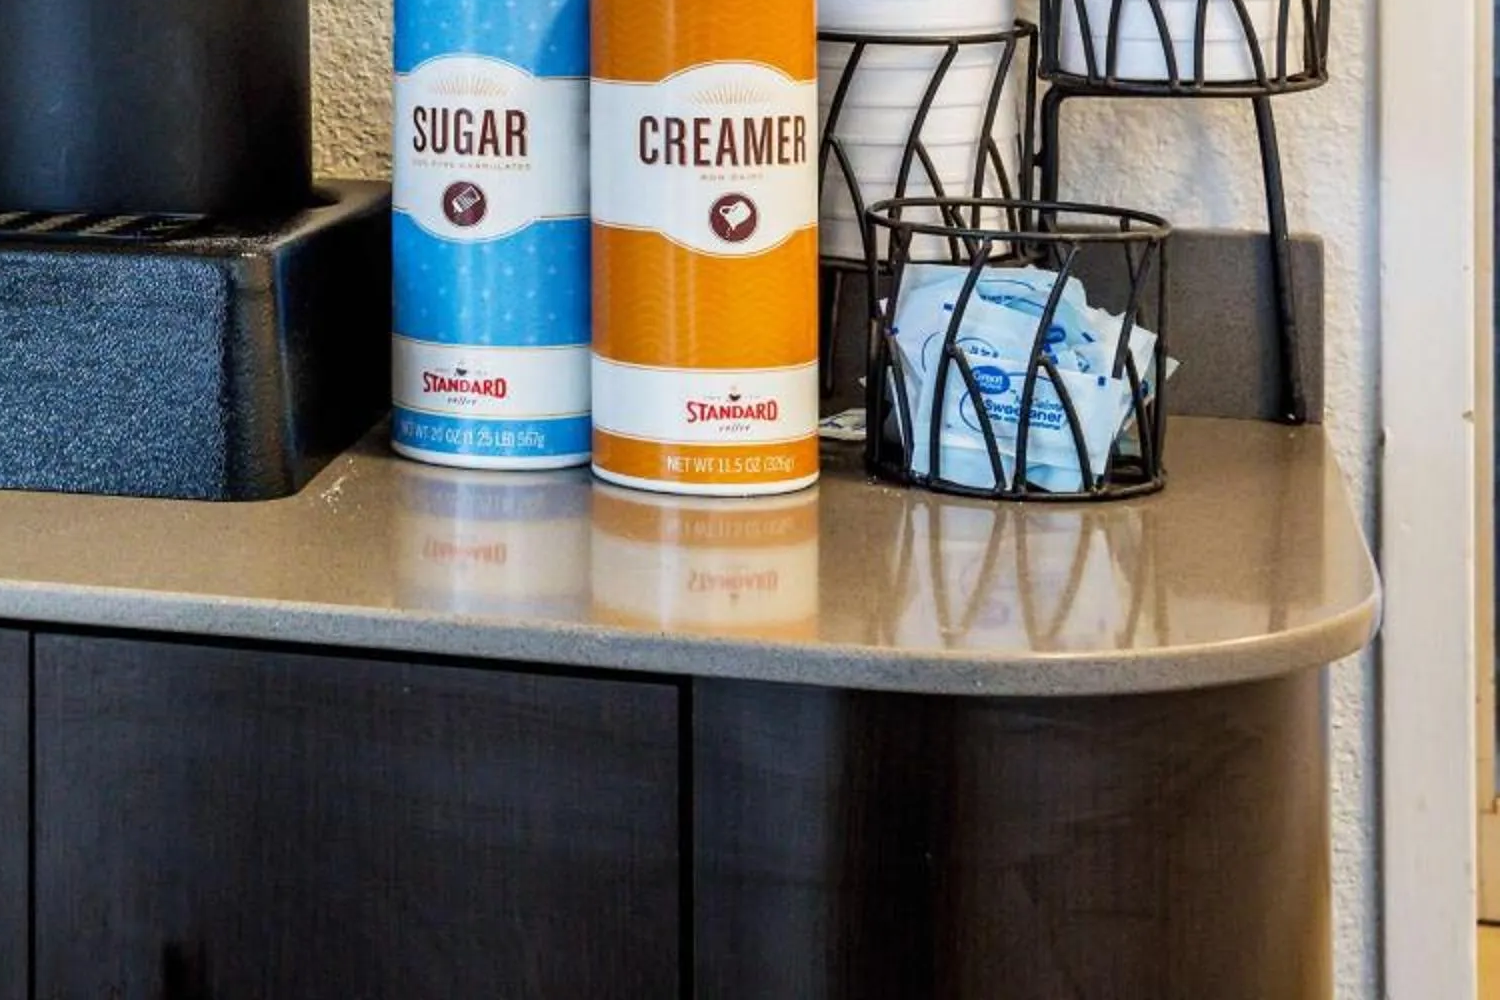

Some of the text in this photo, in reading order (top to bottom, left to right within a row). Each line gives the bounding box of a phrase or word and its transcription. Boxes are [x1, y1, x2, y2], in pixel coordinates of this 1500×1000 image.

[413, 105, 528, 157] SUGAR
[639, 115, 807, 166] CREAMER
[423, 371, 507, 399] STANDARD
[687, 400, 778, 423] STANDARD
[984, 398, 1062, 423] Sweeener
[667, 455, 690, 473] NET
[693, 456, 714, 473] WT
[745, 457, 762, 473] OZ
